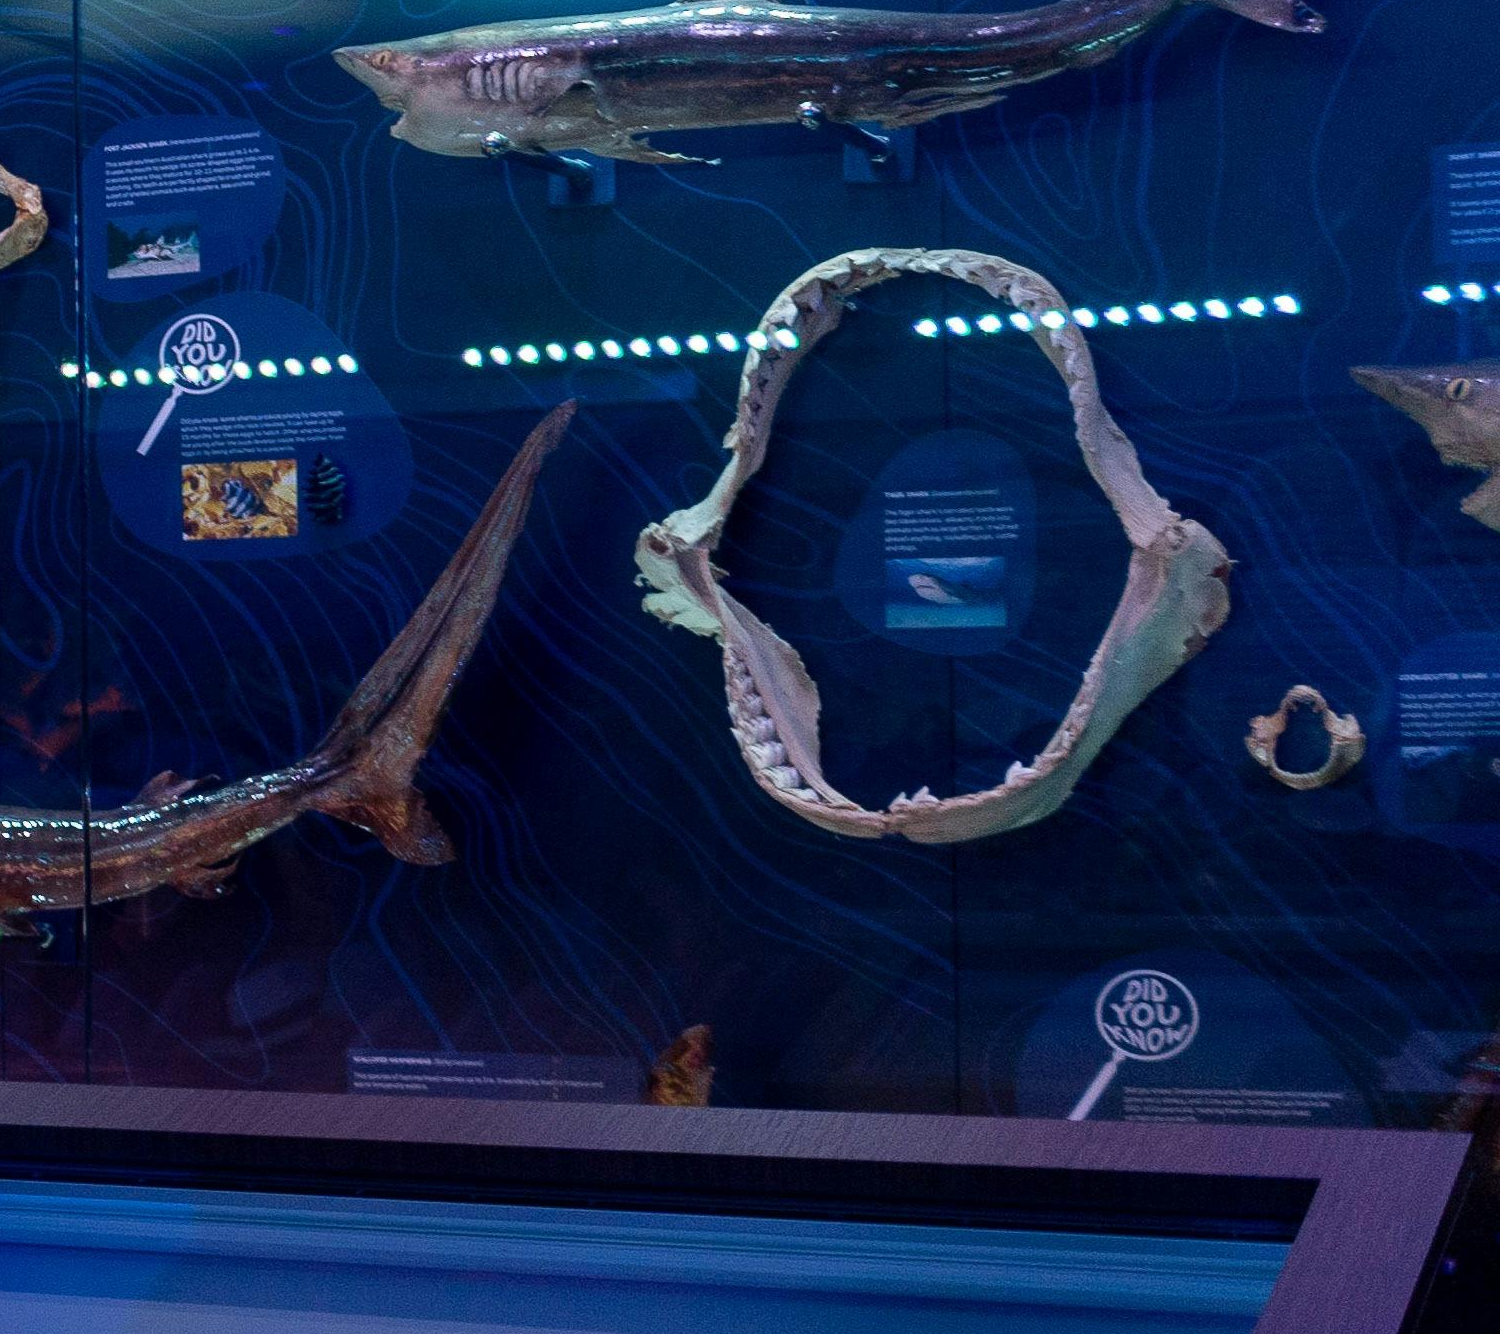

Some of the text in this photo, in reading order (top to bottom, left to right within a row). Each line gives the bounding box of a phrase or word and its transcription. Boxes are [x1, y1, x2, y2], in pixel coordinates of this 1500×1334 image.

[181, 321, 217, 345] DID
[171, 343, 227, 366] YOU
[1123, 978, 1168, 1003] DID
[1110, 1002, 1182, 1027] YOU
[1103, 1023, 1190, 1053] KNOW
